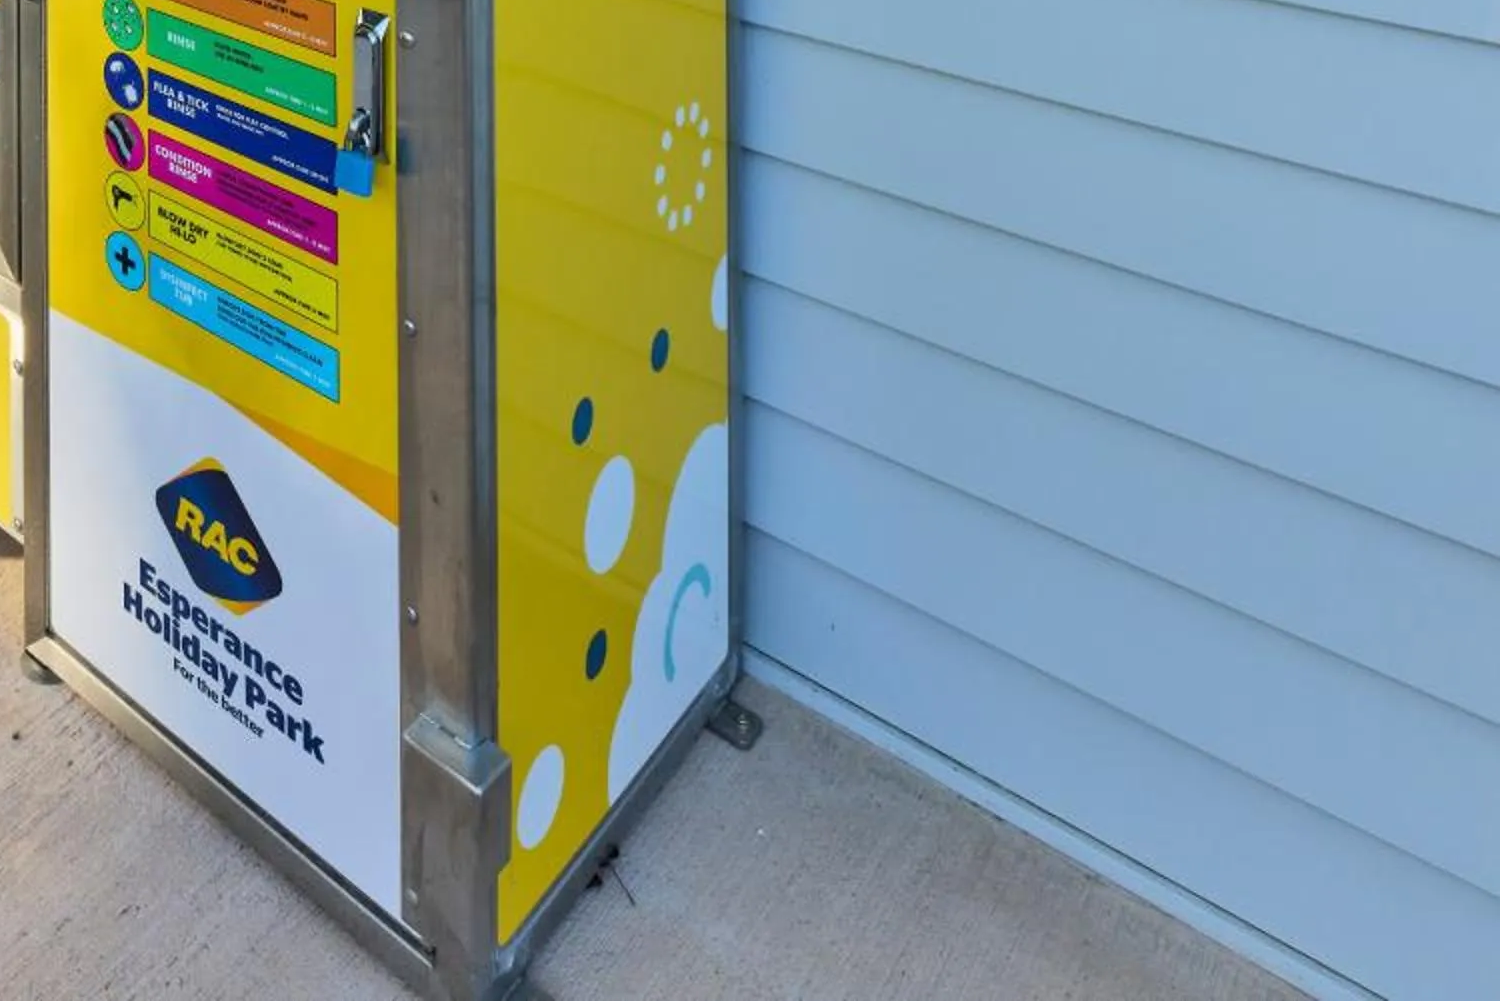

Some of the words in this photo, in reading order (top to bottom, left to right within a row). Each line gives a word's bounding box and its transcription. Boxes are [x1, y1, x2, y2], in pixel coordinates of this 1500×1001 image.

[166, 30, 196, 52] RINSE
[153, 79, 175, 99] FLEA
[186, 93, 210, 113] TICK
[166, 98, 197, 120] RINSE
[155, 143, 212, 179] CONDITION
[168, 161, 198, 184] RINSE
[157, 205, 187, 227] BLOW
[187, 219, 210, 240] DRY
[174, 496, 260, 576] RAC
[139, 557, 303, 706] Esperance
[123, 581, 239, 699] Holiday
[245, 674, 325, 765] Park
[173, 657, 195, 684] For
[197, 674, 219, 705] the
[221, 690, 265, 739] better
